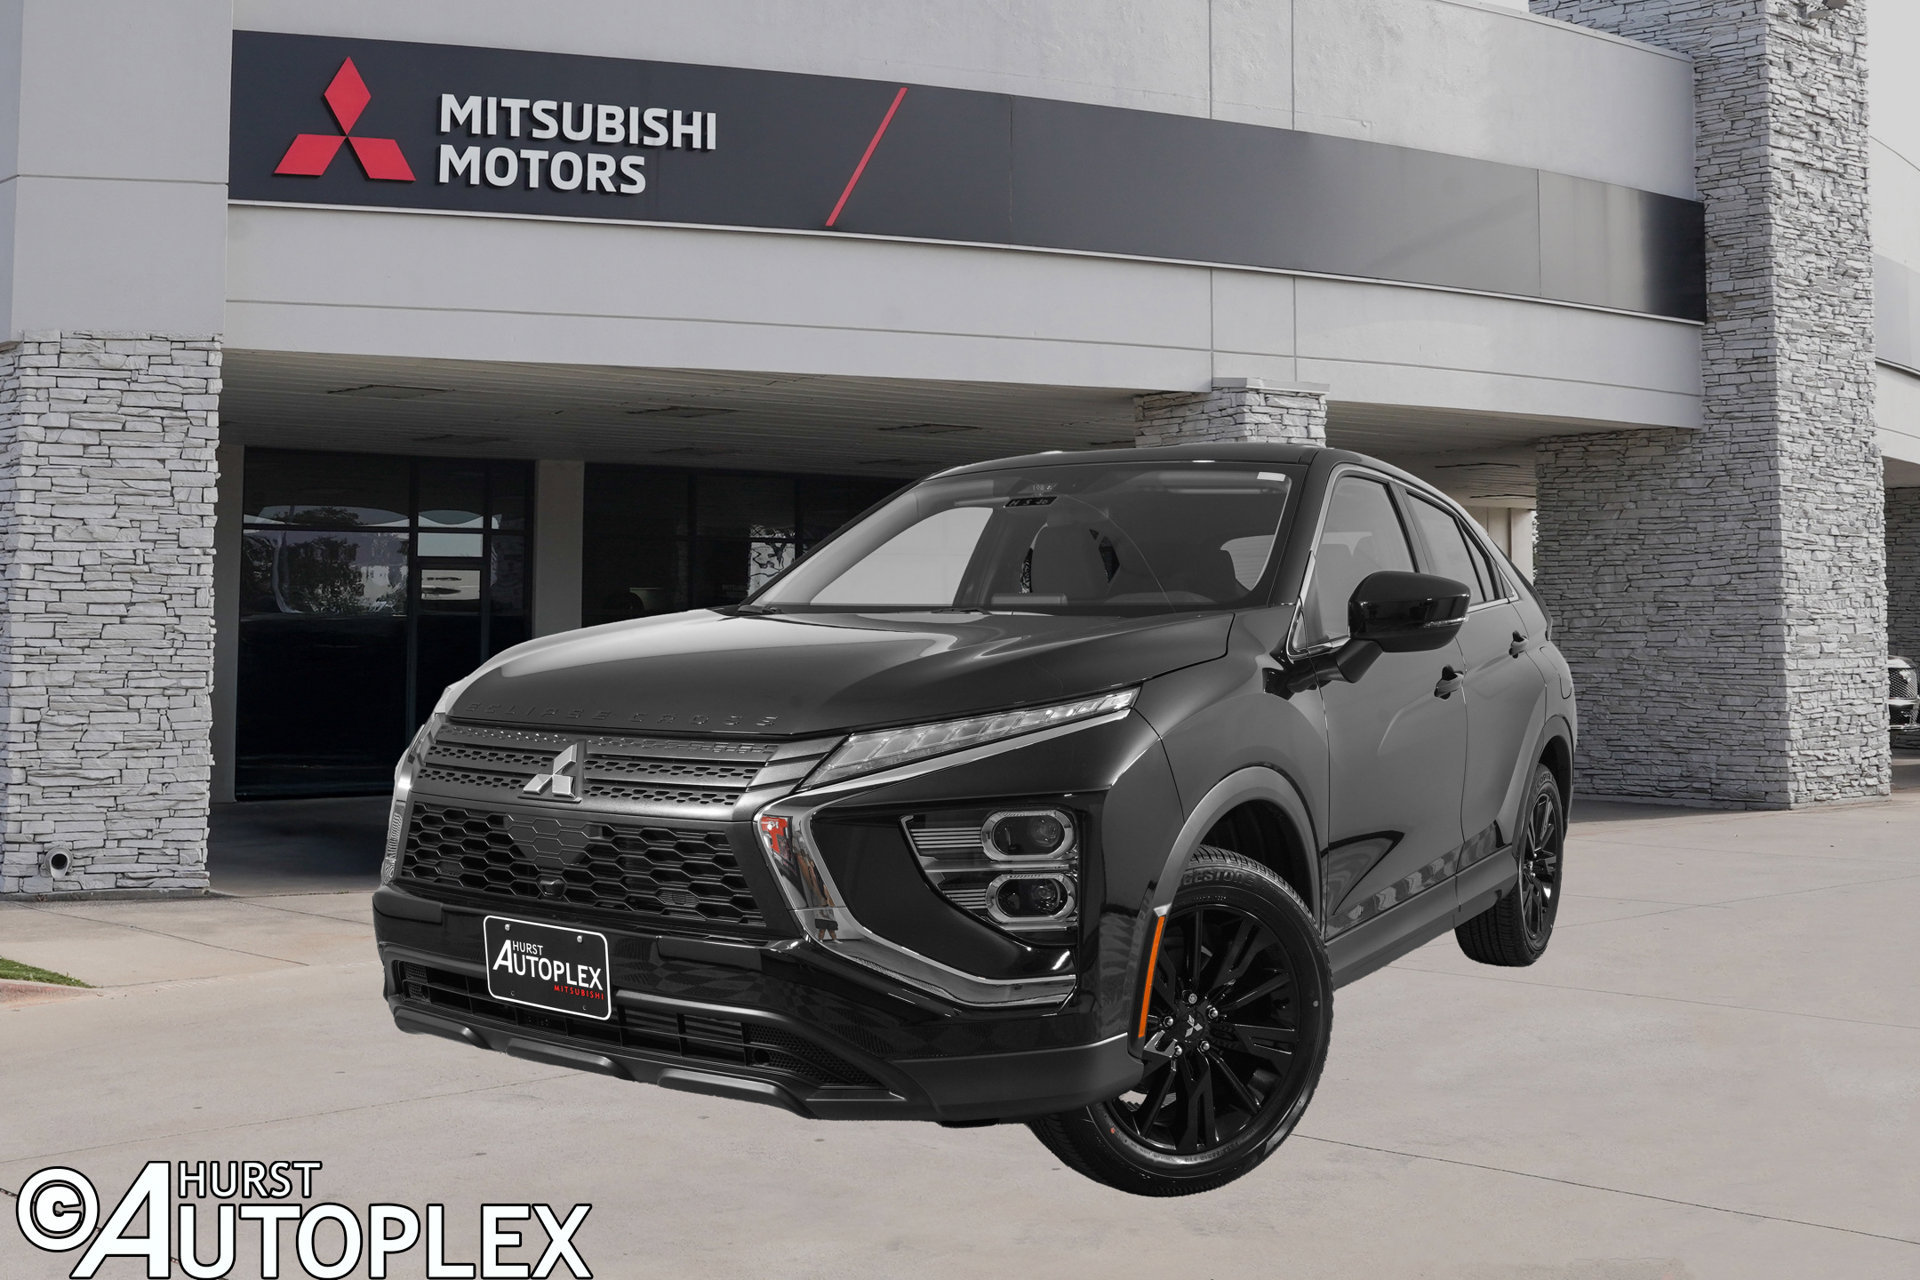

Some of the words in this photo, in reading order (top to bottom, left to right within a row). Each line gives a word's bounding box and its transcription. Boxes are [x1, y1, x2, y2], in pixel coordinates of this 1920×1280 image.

[441, 94, 716, 149] MITSUBISHI
[439, 145, 646, 193] MOTORS
[630, 712, 778, 727] CROSS
[513, 941, 544, 955] HURST
[493, 940, 603, 990] AUTOPLEX
[554, 985, 604, 1000] MITSUBISHI
